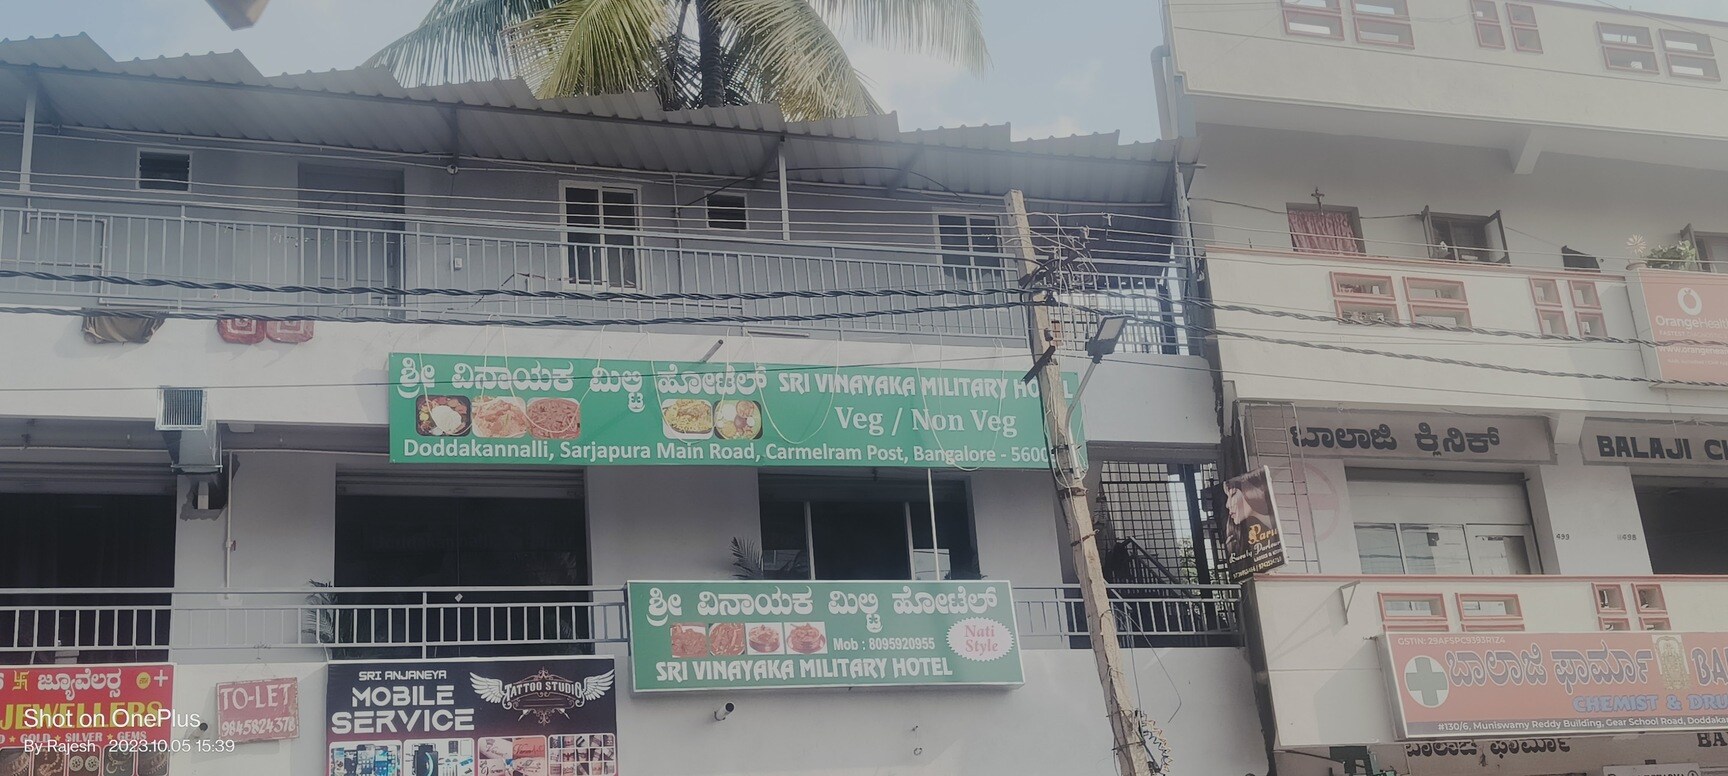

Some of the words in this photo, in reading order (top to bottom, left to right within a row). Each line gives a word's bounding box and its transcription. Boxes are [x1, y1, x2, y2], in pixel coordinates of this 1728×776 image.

[397, 357, 435, 398] ಶ್ರೀ
[450, 361, 574, 391] ವಿನಾಯಕ
[657, 363, 767, 395] ಹೋಟೆಲ್
[779, 372, 810, 395] SRI
[816, 374, 915, 398] VINAYAKA
[921, 377, 1007, 399] MILITARY
[1013, 379, 1074, 399] HOL
[834, 406, 883, 436] Veg
[891, 407, 904, 436] /
[911, 408, 964, 432] Non
[970, 409, 1018, 437] Veg
[404, 438, 555, 461] Doddakannalli,
[560, 440, 651, 462] Sarjapura
[657, 442, 704, 459] Main
[709, 443, 760, 461] Road,
[765, 443, 863, 461] Carmelram
[867, 446, 908, 463] Post,
[914, 445, 996, 465] Bangalore
[1011, 446, 1056, 462] 5600
[1289, 423, 1397, 451] ಬಾಲಾಜಿ
[1415, 421, 1500, 457] ಕ್ಲಿನಿಕ್
[1597, 435, 1692, 460] BALAJI
[646, 586, 682, 626] ಶ್ರೀ
[698, 586, 812, 615] ವಿನಾಯಕ
[892, 585, 997, 615] ಹೋಟೆಲ್
[834, 637, 859, 651] Mob
[868, 637, 935, 651] 8095920955
[964, 625, 995, 638] Nati
[1397, 637, 1426, 646] GSTIN:
[965, 639, 999, 654] Style
[358, 670, 382, 681] SRI
[385, 670, 447, 681] ANJANEYA
[656, 662, 688, 682] SRI
[694, 658, 794, 682] VINAYAKA
[799, 658, 887, 680] MILITARY
[895, 657, 952, 676] HOTEL
[1446, 643, 1548, 687] ಬಾಲಾಜಿ
[1692, 647, 1728, 687] BA
[220, 683, 293, 711] TO-LET
[352, 685, 455, 708] MOBILE
[503, 681, 543, 700] TATTOO
[545, 681, 584, 699] STUDIO
[0, 701, 163, 730] JEWELLERS
[1572, 694, 1659, 713] CHEMIST
[1665, 694, 1683, 711] &
[331, 708, 475, 734] SERVICE
[1438, 723, 1472, 732] #130/6,
[1473, 721, 1530, 732] Muniswamy
[1532, 720, 1561, 730] Reddy
[1563, 718, 1604, 730] Building,
[1606, 717, 1627, 727] Gear
[1628, 716, 1659, 727] School
[1661, 716, 1686, 727] Road,
[20, 733, 51, 744] GOLD
[65, 732, 104, 742] SILVER
[117, 731, 147, 742] GEMS
[1697, 733, 1728, 748] BA
